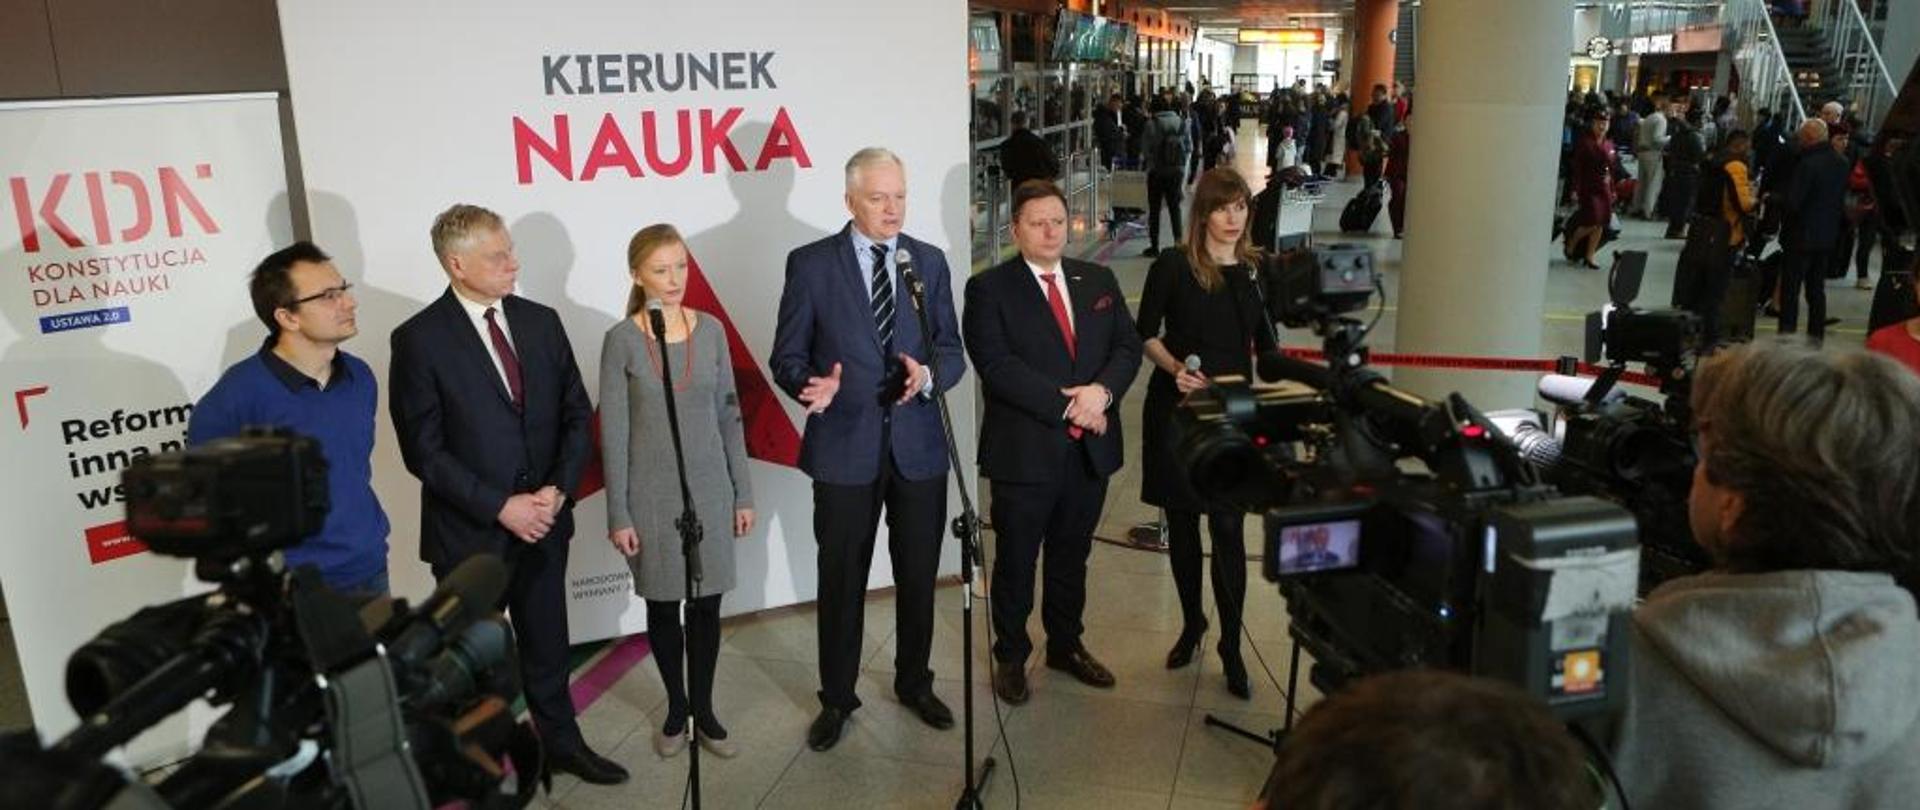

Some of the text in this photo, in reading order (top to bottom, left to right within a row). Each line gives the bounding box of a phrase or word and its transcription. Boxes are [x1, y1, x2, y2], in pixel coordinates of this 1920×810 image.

[542, 51, 777, 96] KIERUNEK
[512, 107, 812, 184] NAUKA
[28, 248, 206, 283] KONSTYTUCJA
[33, 274, 170, 307] DLA NAUKI
[51, 311, 120, 329] USTAWA 2.0
